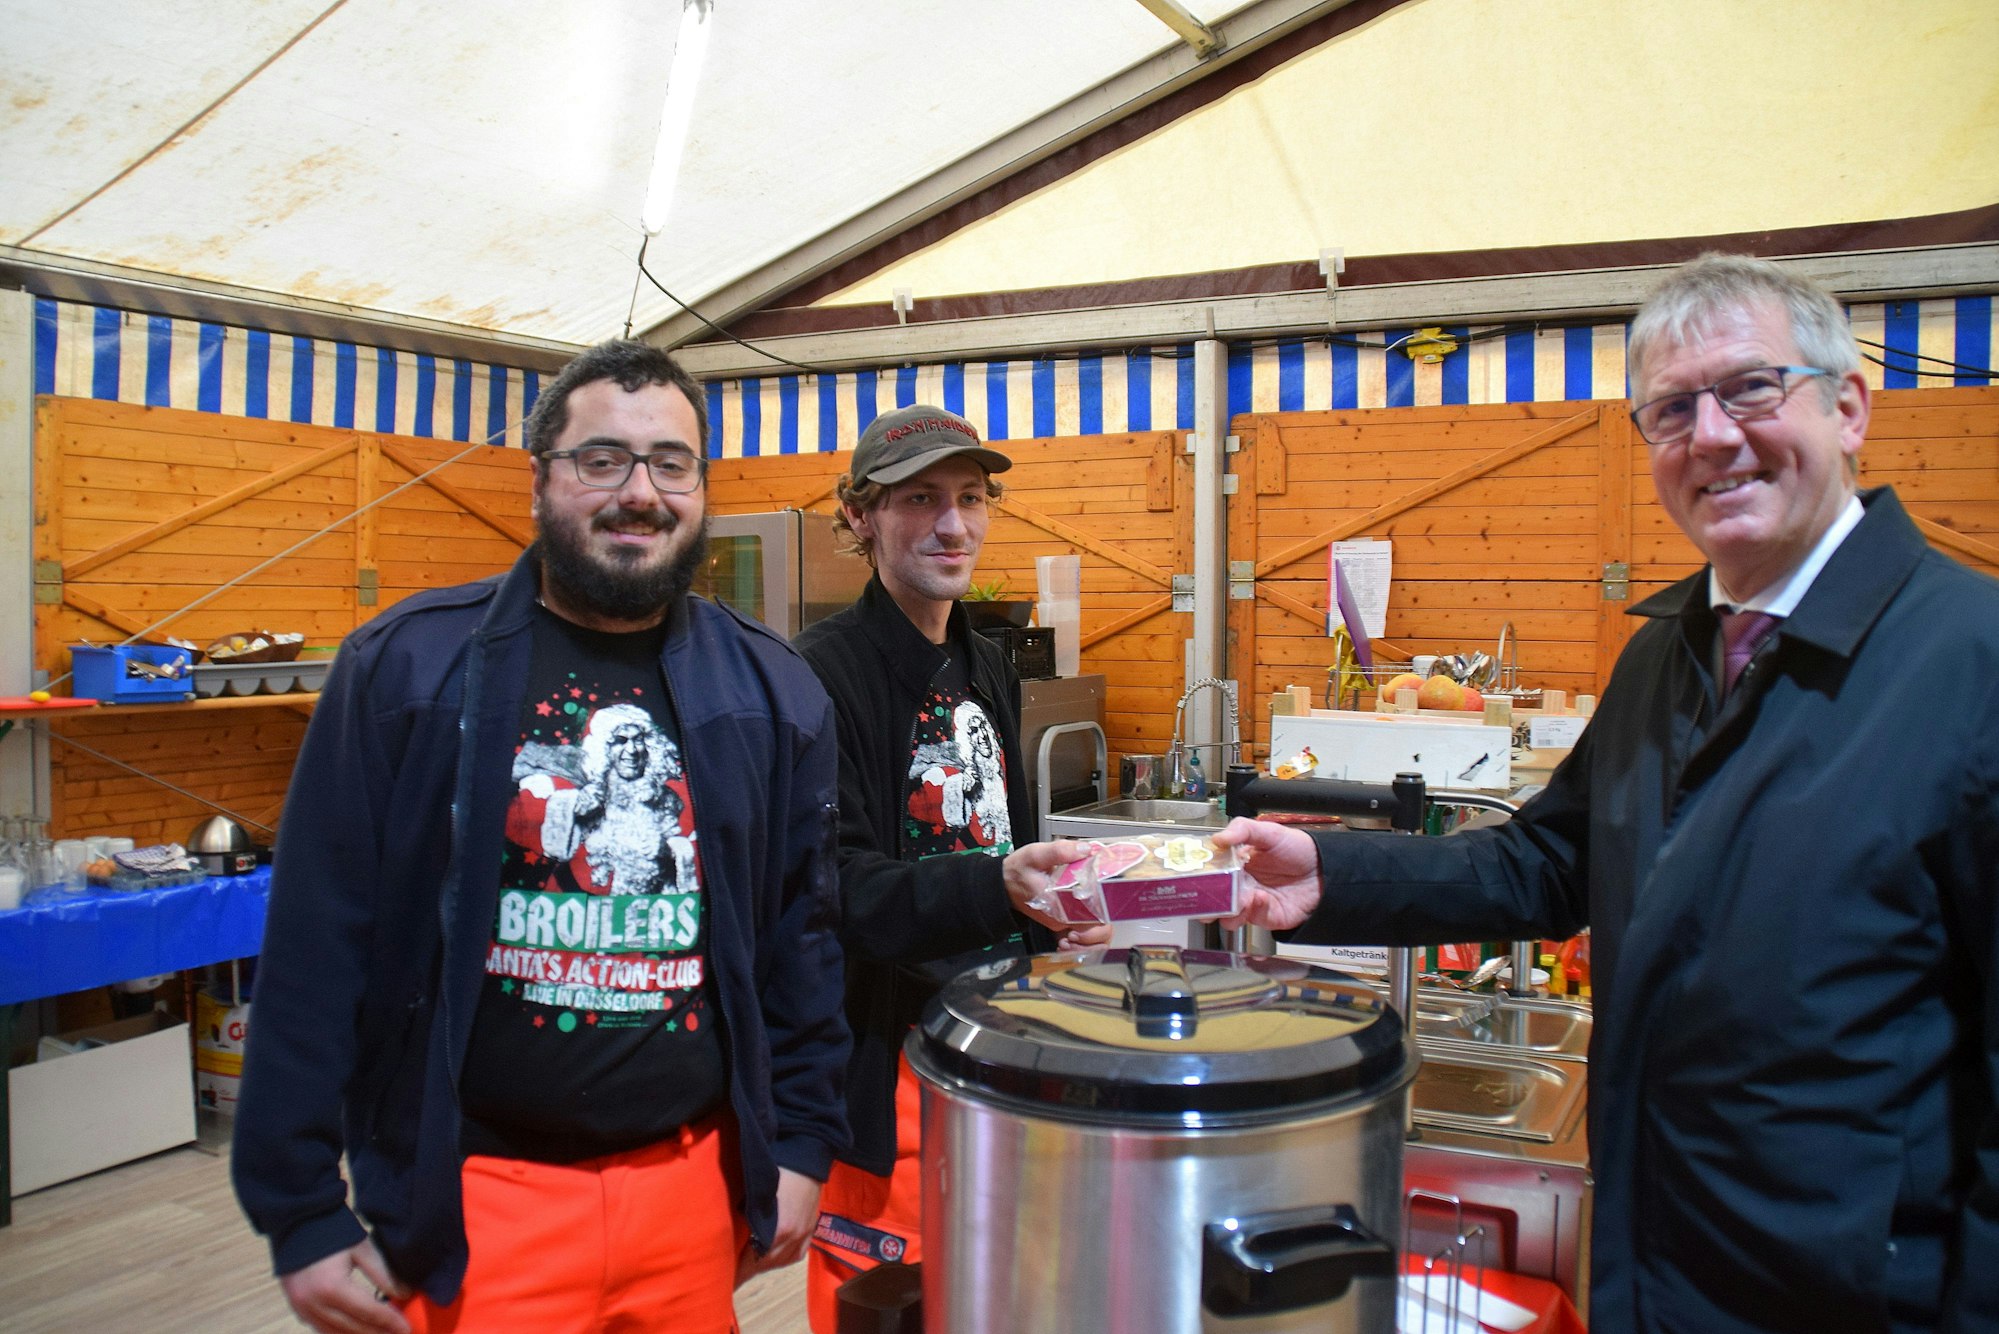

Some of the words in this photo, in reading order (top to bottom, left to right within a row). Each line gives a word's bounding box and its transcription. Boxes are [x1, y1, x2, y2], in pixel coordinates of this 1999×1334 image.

[500, 891, 699, 948] BROILERS
[485, 946, 562, 982] ANTA'S
[523, 983, 555, 1005] LIVE
[556, 985, 573, 1006] IN
